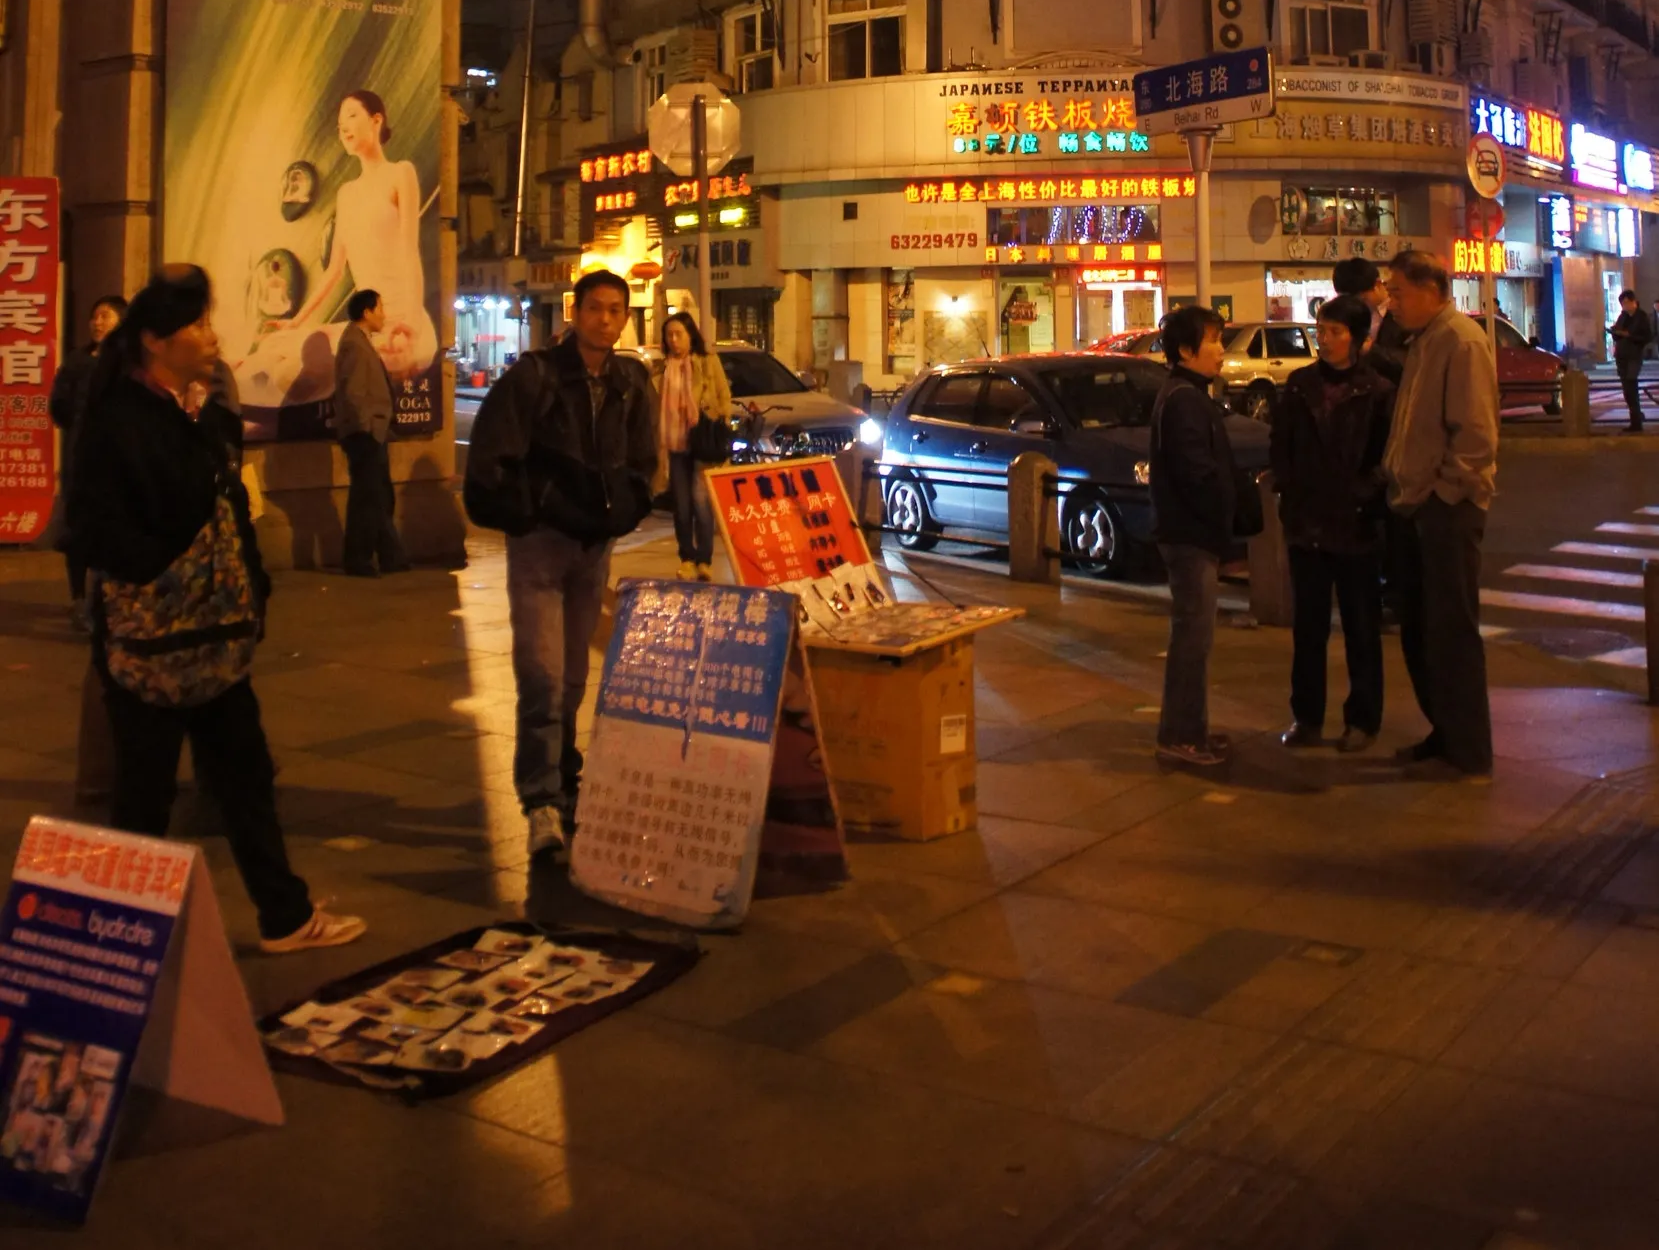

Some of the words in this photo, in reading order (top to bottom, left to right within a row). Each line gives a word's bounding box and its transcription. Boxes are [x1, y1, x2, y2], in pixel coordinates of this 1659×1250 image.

[938, 81, 1024, 97] JAPANESE
[1037, 78, 1134, 94] TEPPANYA
[1166, 65, 1229, 103] 北海路
[1347, 80, 1361, 93] OF
[1204, 106, 1220, 122] Rd
[1250, 99, 1263, 113] W
[948, 97, 1138, 136] 嘉顿铁板烧
[890, 232, 979, 250] 63229479
[396, 396, 432, 411] OGA
[729, 497, 792, 524] 永久免费
